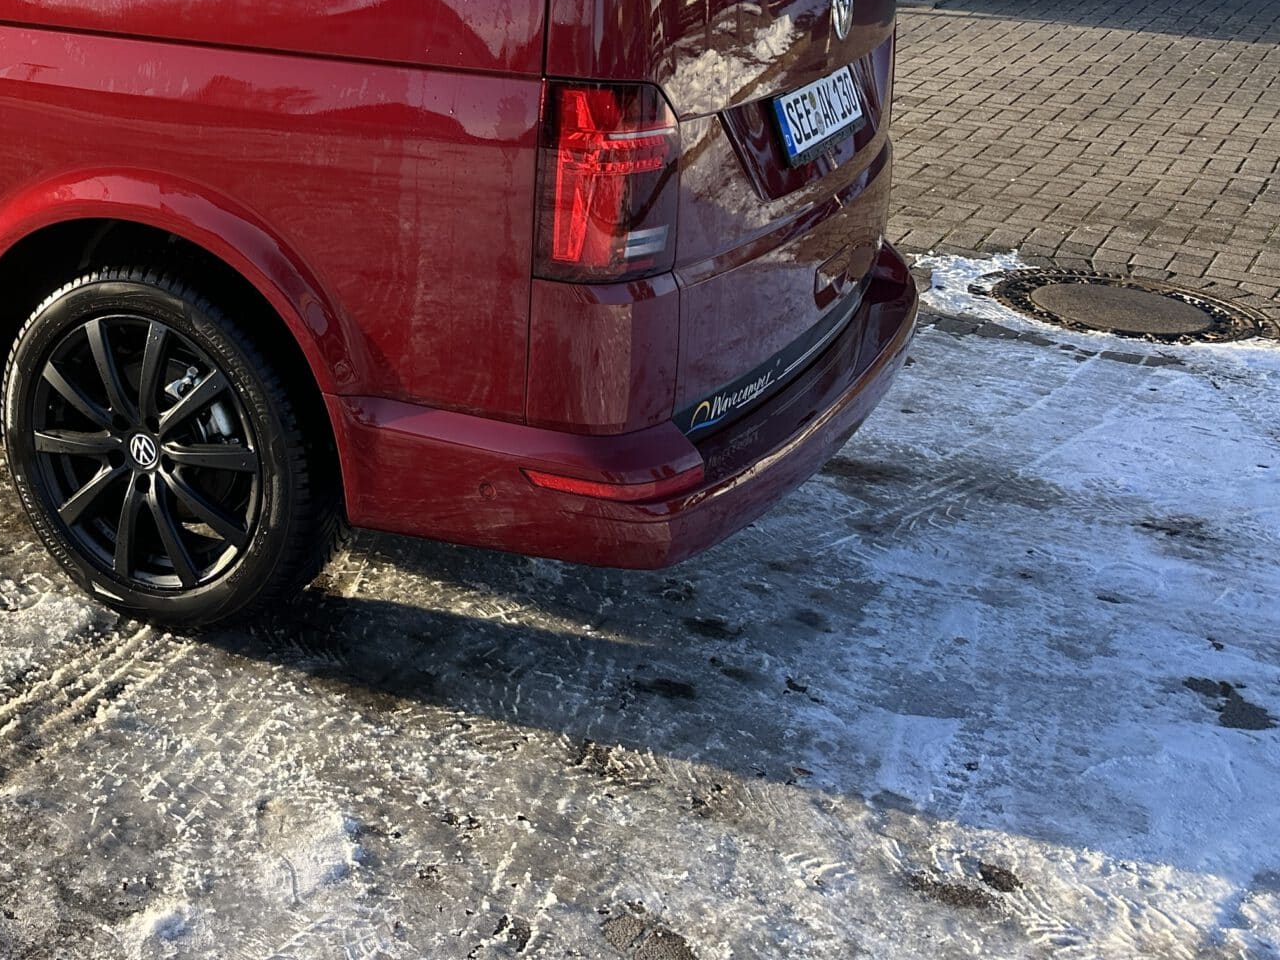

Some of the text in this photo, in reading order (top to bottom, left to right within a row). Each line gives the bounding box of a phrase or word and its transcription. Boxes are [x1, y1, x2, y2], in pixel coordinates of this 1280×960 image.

[785, 72, 858, 145] SEE AK 130
